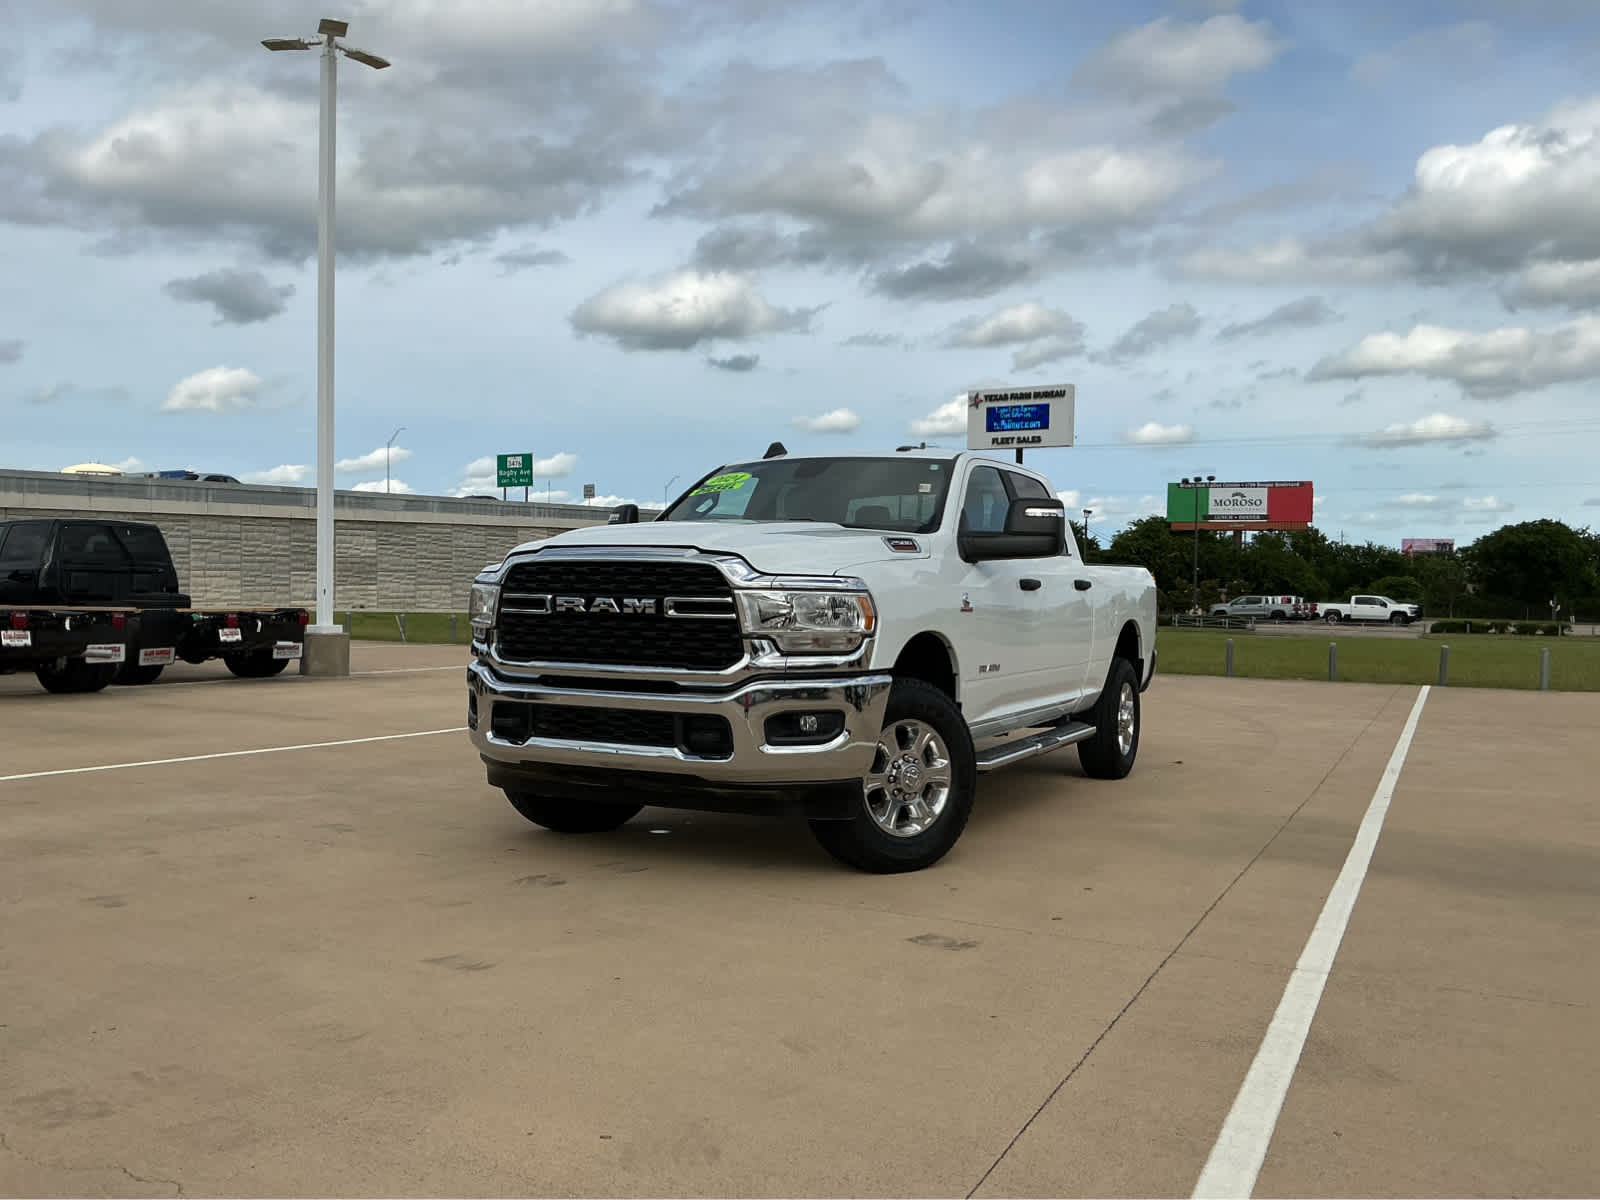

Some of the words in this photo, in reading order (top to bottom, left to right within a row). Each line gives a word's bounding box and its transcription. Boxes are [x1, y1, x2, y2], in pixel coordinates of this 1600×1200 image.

[984, 393, 1008, 402] TEXAS
[1010, 391, 1032, 400] FARM
[1033, 390, 1066, 399] BUREAU
[992, 436, 1016, 445] FLEET
[1017, 436, 1041, 444] SALES
[499, 469, 517, 477] Bagby
[1213, 498, 1263, 507] MOROSO
[555, 596, 656, 614] RAM
[978, 663, 1001, 673] RAM
